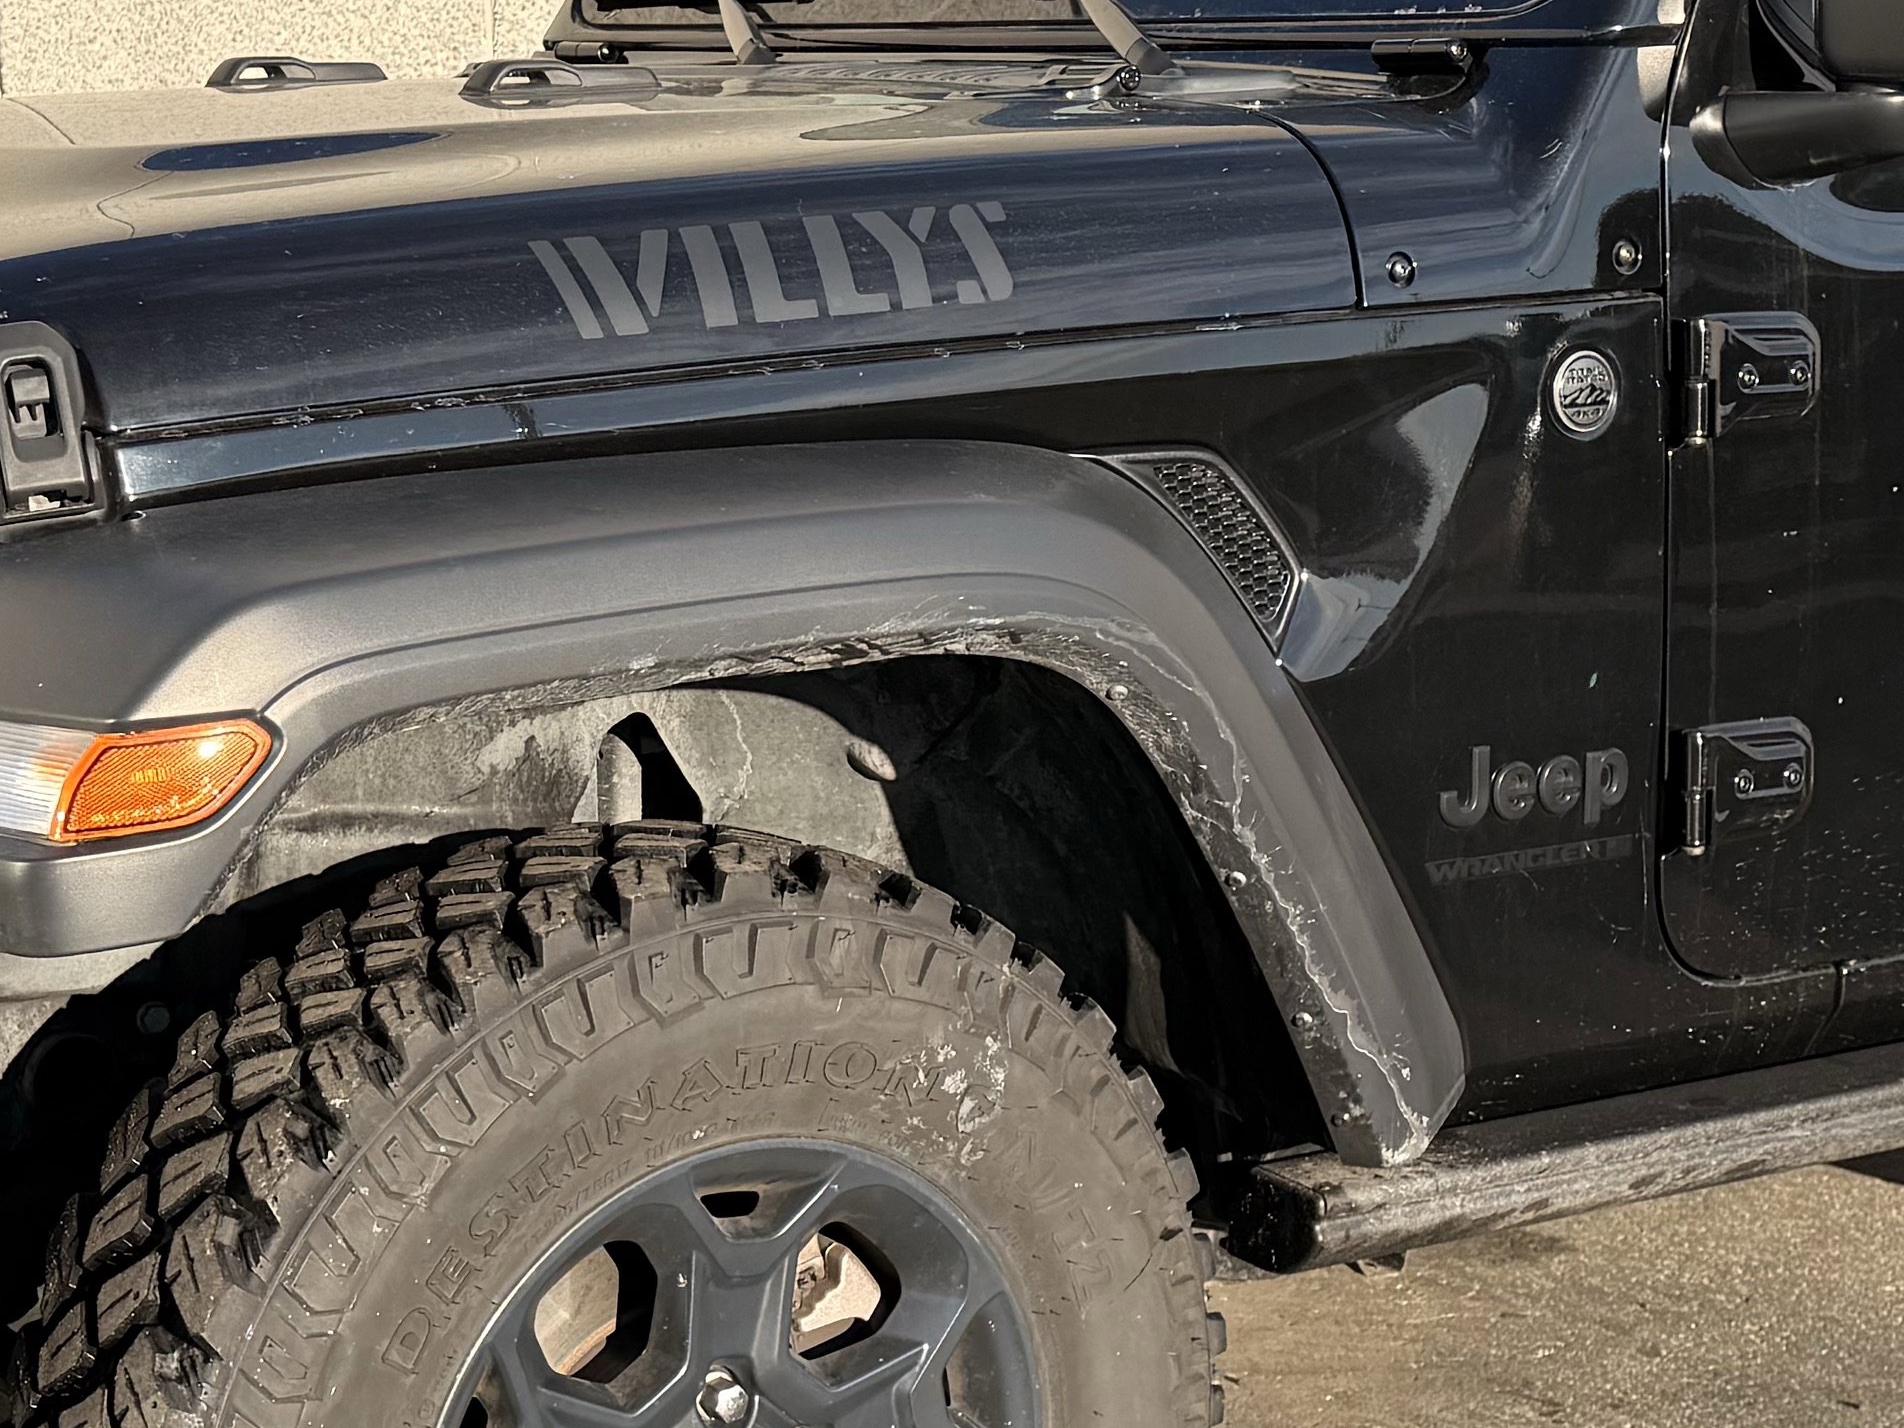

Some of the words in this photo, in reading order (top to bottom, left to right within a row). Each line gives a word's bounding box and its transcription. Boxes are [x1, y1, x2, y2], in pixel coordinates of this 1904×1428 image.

[528, 202, 1014, 340] WILLYS
[1439, 744, 1629, 828] Jeep
[380, 1039, 948, 1374] DESTINATION
